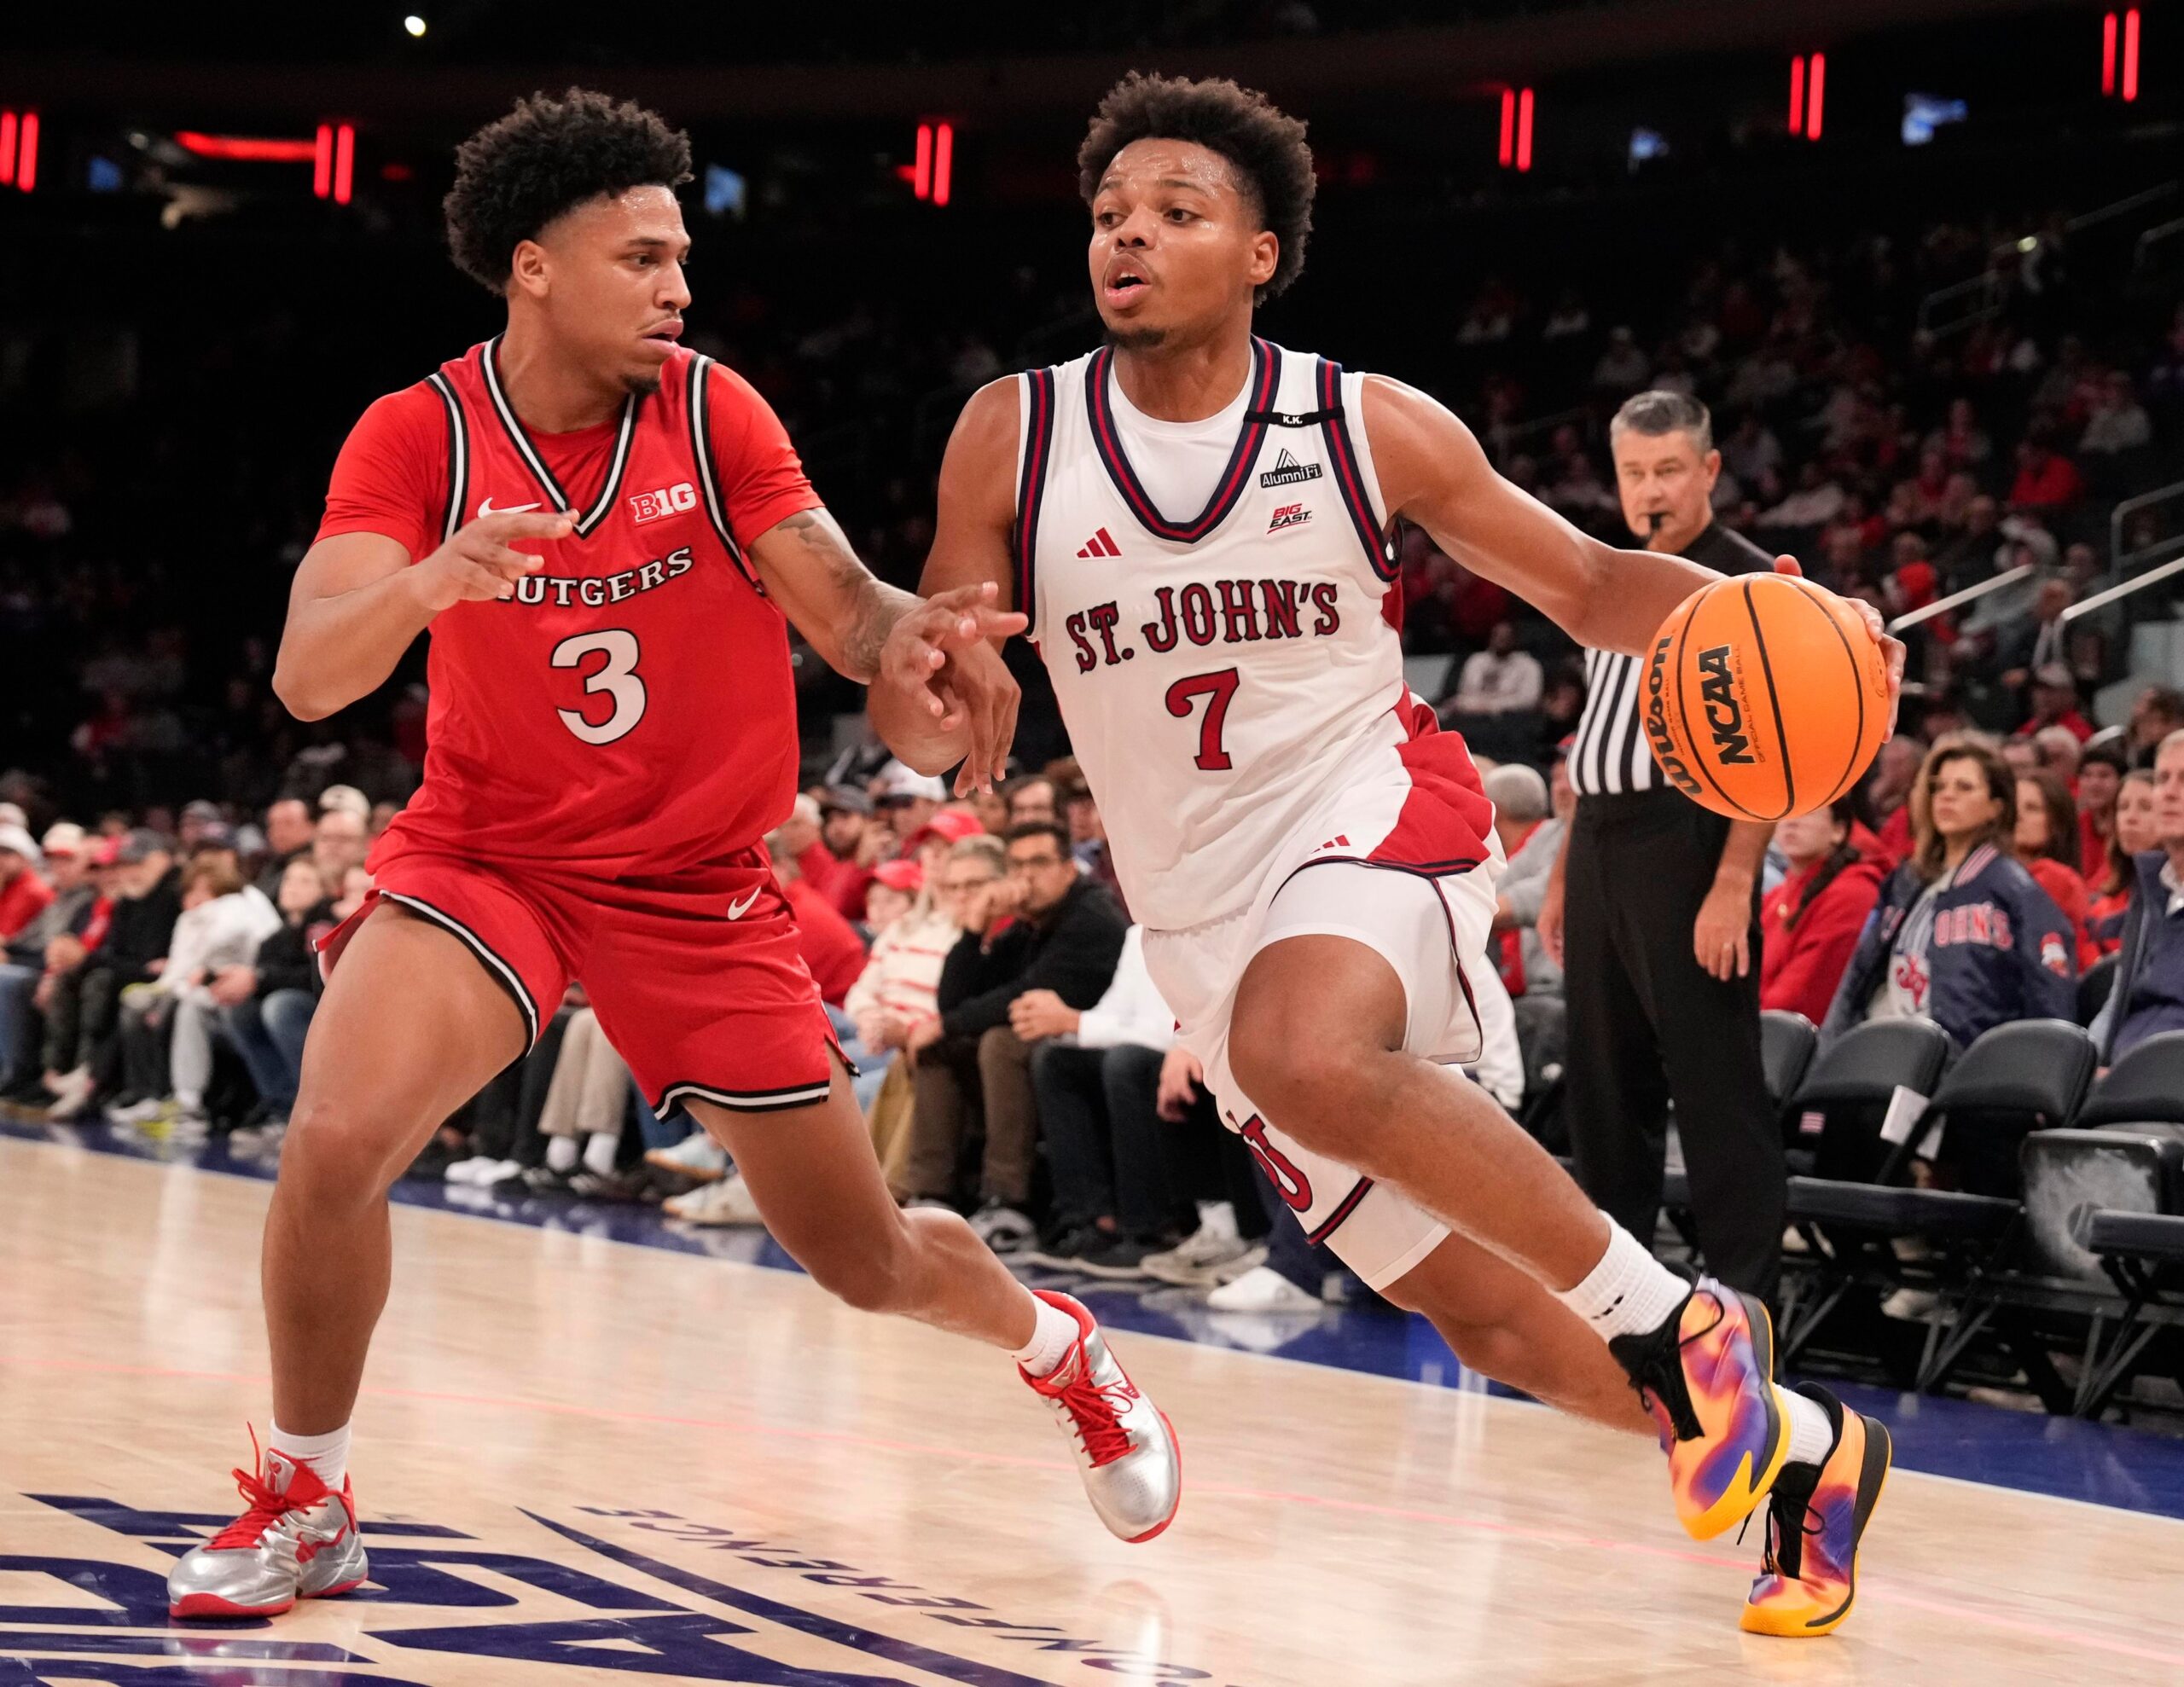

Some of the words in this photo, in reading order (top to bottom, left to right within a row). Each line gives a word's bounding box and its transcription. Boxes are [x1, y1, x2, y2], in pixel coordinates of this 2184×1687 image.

[1282, 415, 1304, 425] K.K.
[1262, 464, 1321, 487] AlumniFi
[1269, 511, 1311, 528] EAST
[1272, 503, 1303, 519] BIG
[497, 546, 695, 607] UTGERS
[1066, 600, 1135, 675] ST.
[1141, 579, 1340, 652] JOHN'S
[549, 628, 648, 746] 3
[1735, 644, 1744, 675] BALL
[1165, 667, 1240, 771] 7
[1647, 636, 1702, 796] Wilson
[1699, 645, 1756, 765] NCAA
[1740, 678, 1751, 712] GAME
[1746, 714, 1766, 763] OFFICIAL
[574, 1505, 1243, 1687] ONFERENCE
